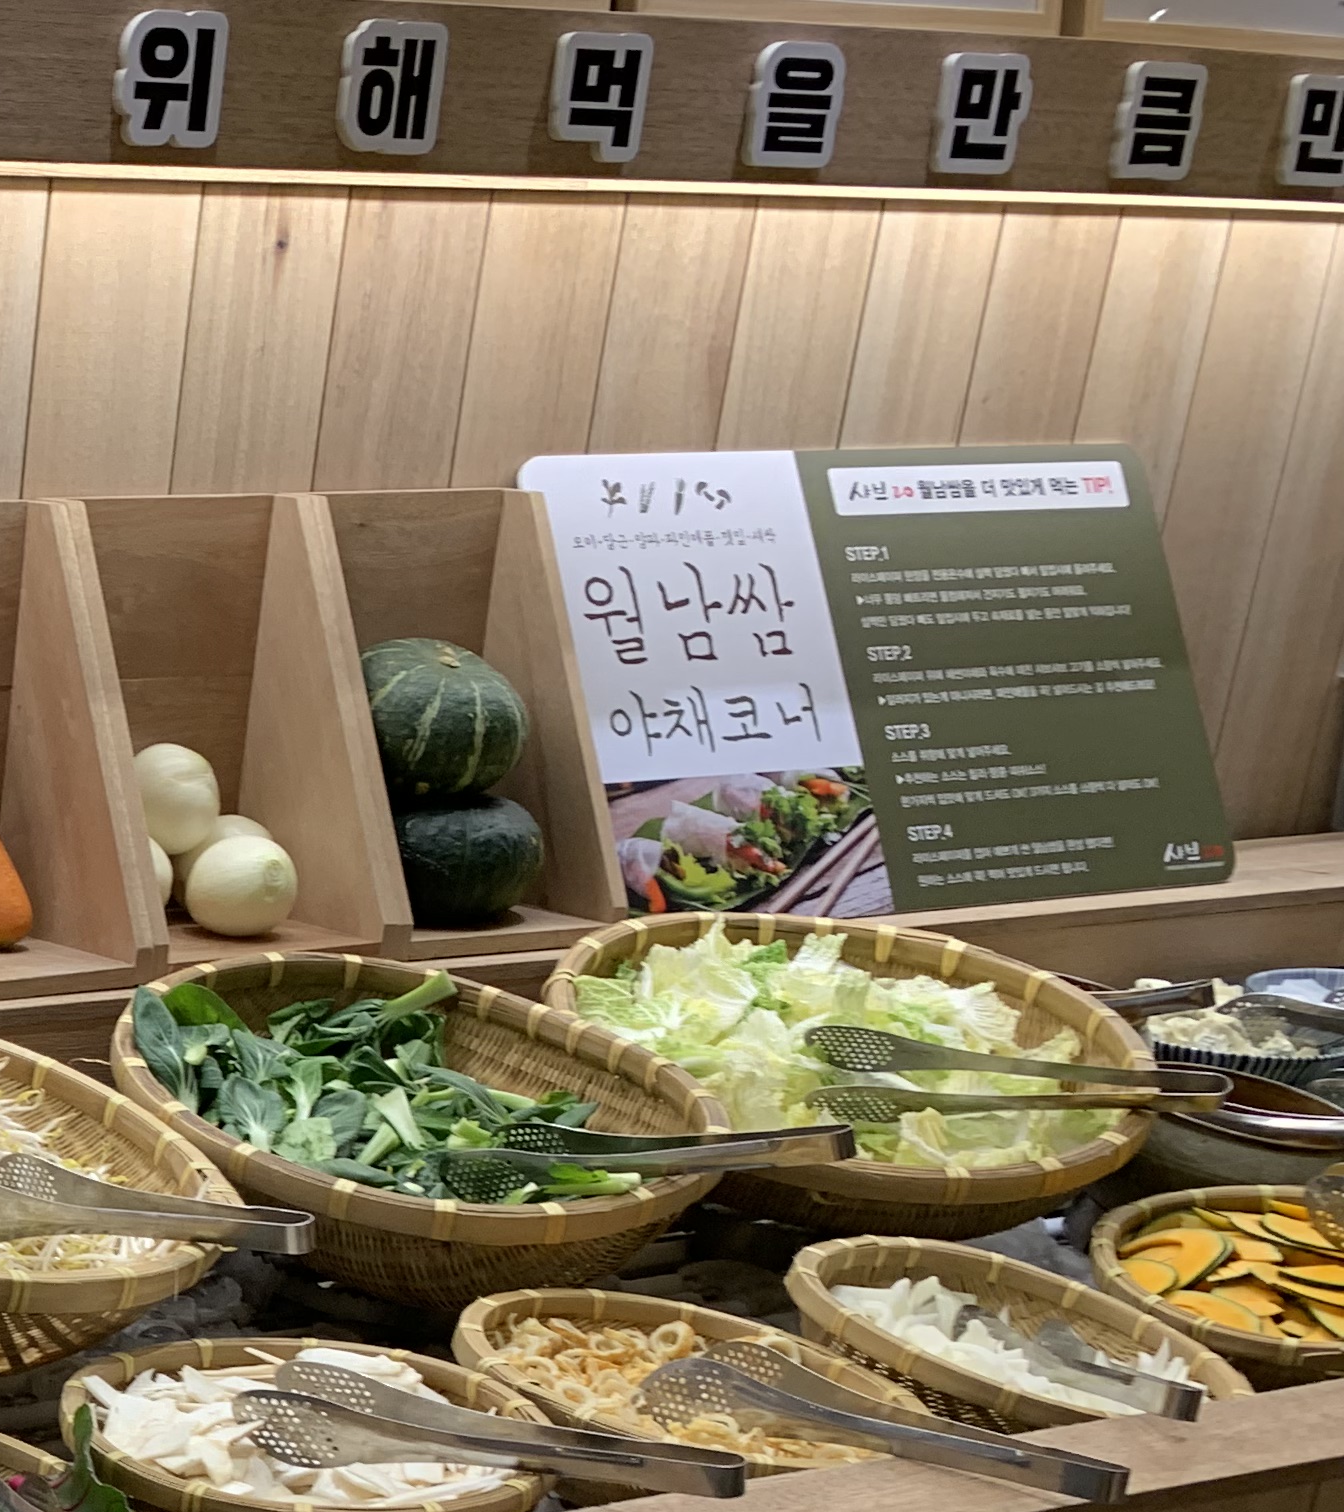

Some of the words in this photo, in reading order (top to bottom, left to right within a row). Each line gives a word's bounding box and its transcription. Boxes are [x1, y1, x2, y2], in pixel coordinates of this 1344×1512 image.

[981, 479, 996, 498] 더
[1080, 475, 1114, 495] TIP!
[845, 545, 890, 562] STEP.1
[583, 561, 795, 664] 월남쌈
[866, 645, 913, 661] STEP.2
[884, 723, 931, 740] STEP.3
